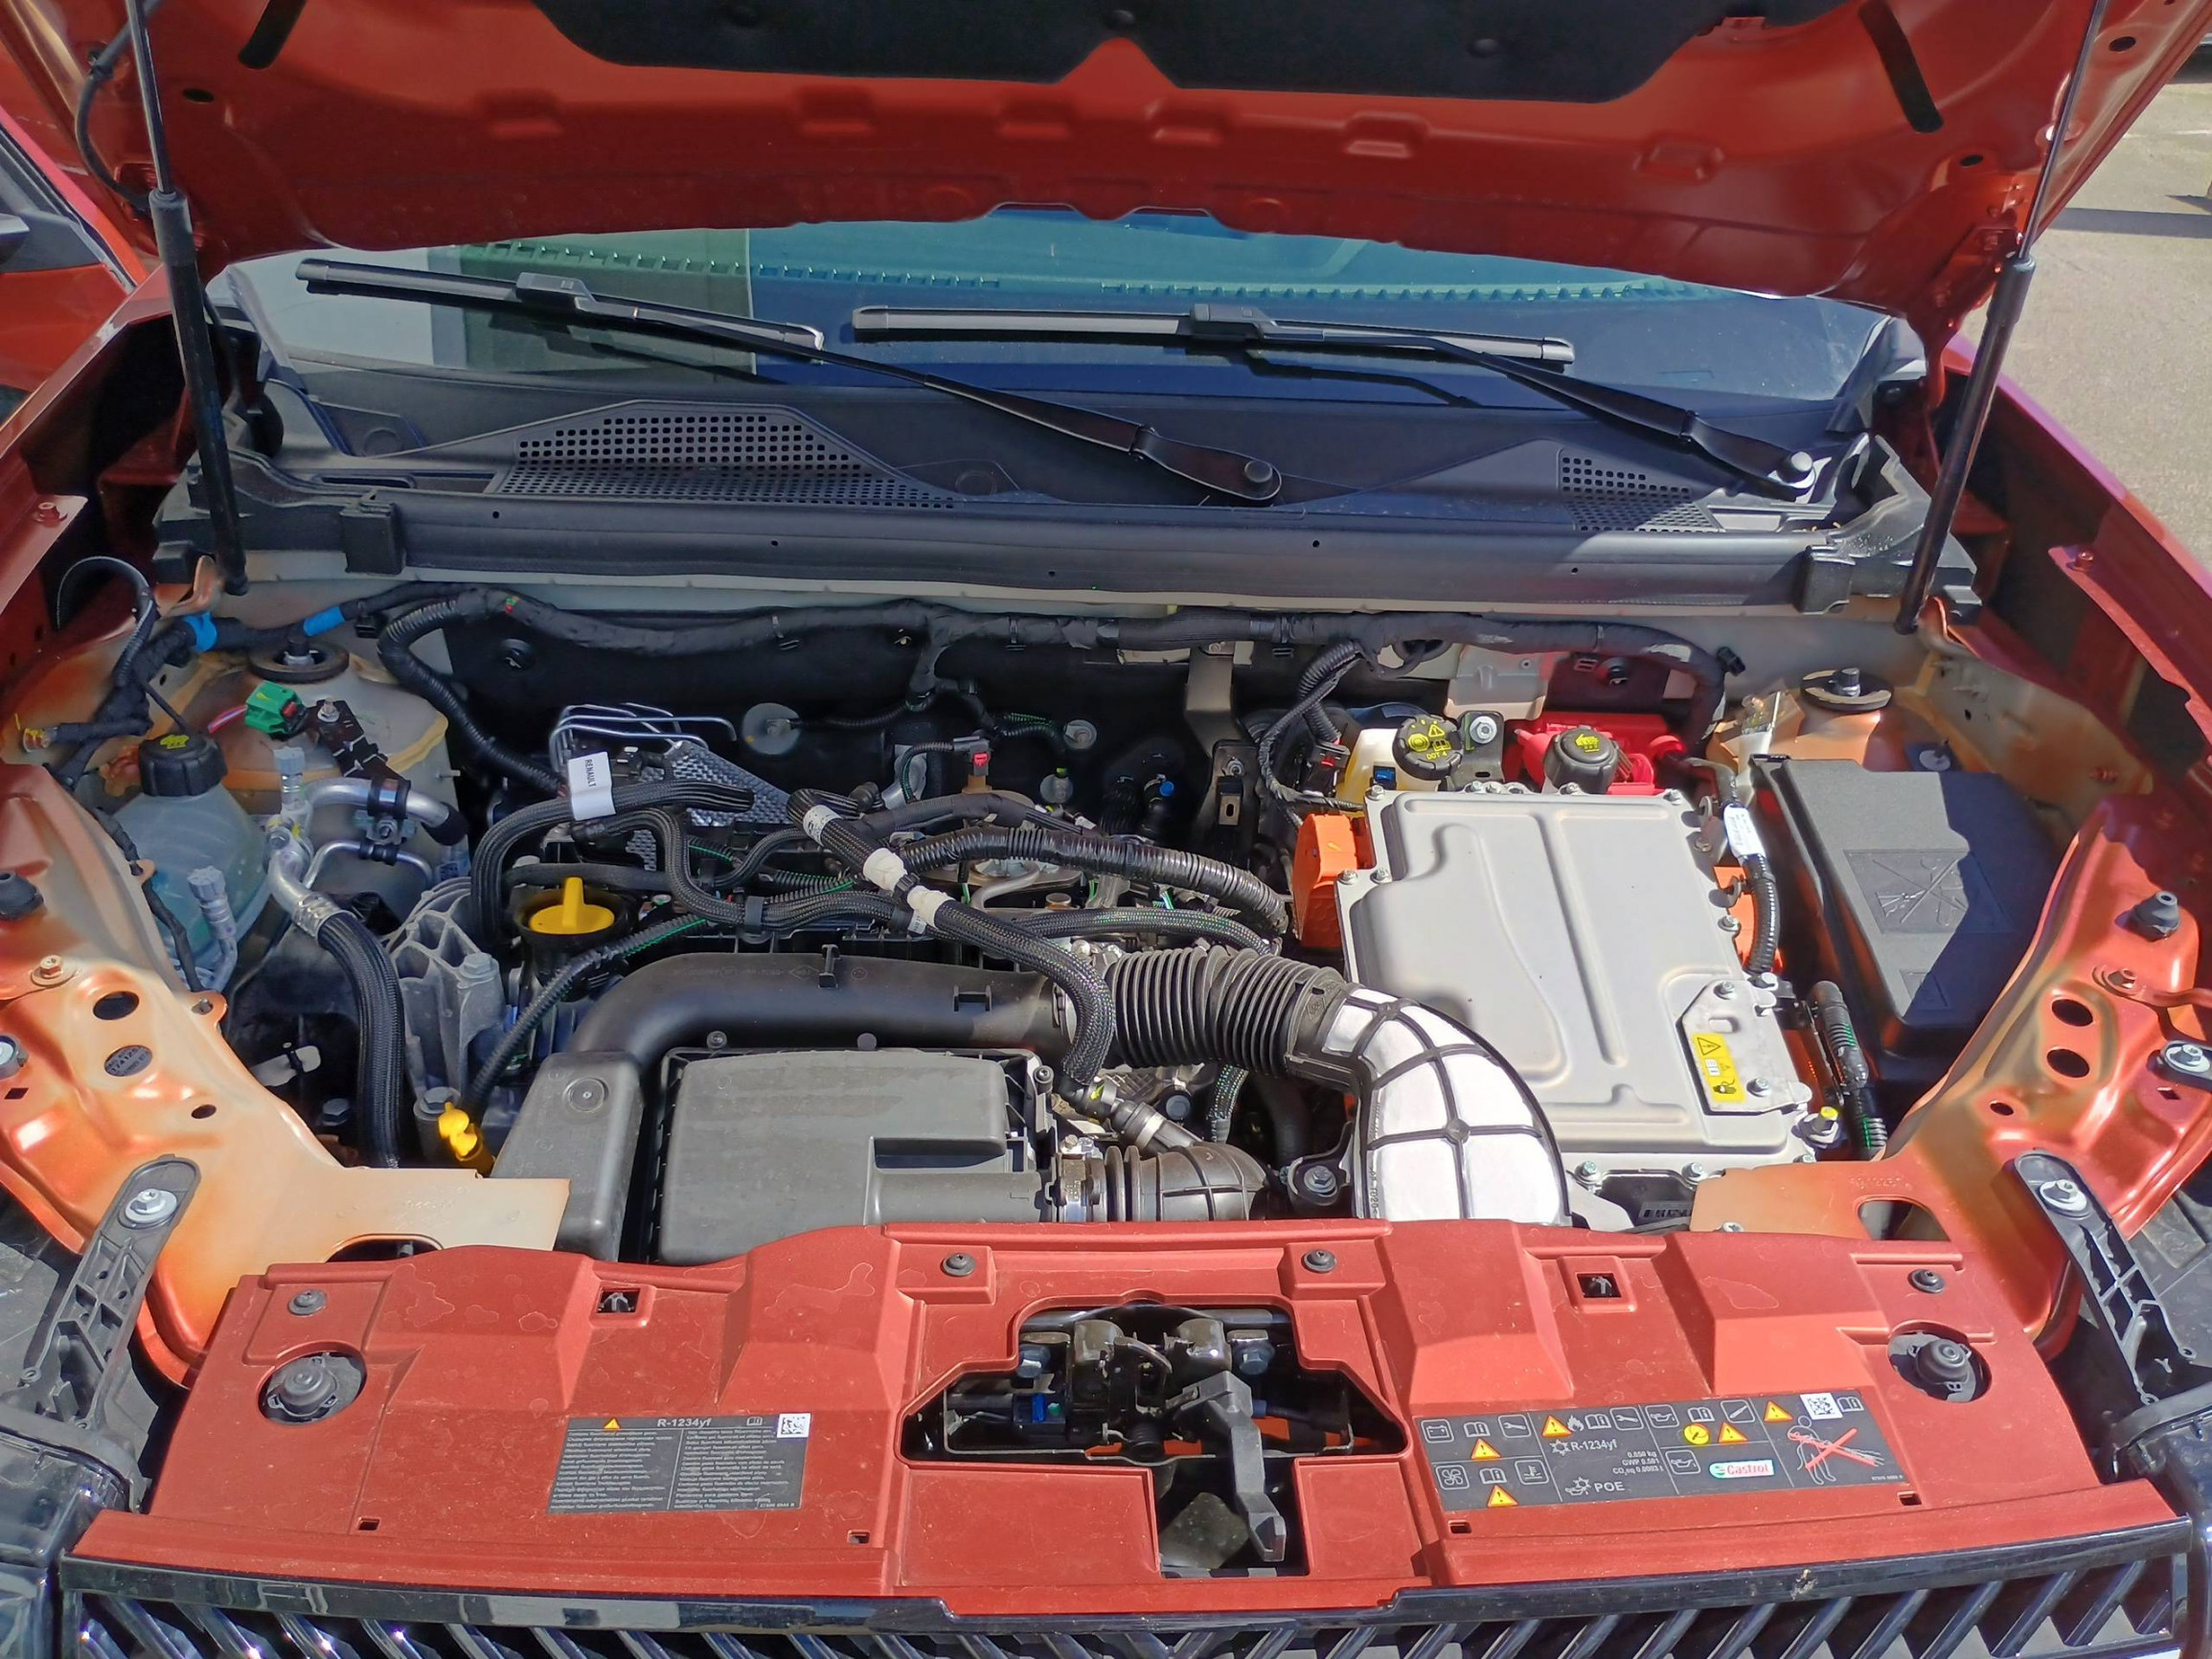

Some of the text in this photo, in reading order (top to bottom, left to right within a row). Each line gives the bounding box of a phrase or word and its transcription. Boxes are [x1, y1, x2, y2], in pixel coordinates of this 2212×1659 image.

[584, 759, 596, 787] RENAULT
[657, 1418, 712, 1429] R-1234yf
[1570, 1439, 1617, 1451] R-1234yf
[1726, 1463, 1768, 1475] Castrol
[1594, 1481, 1626, 1493] POE
